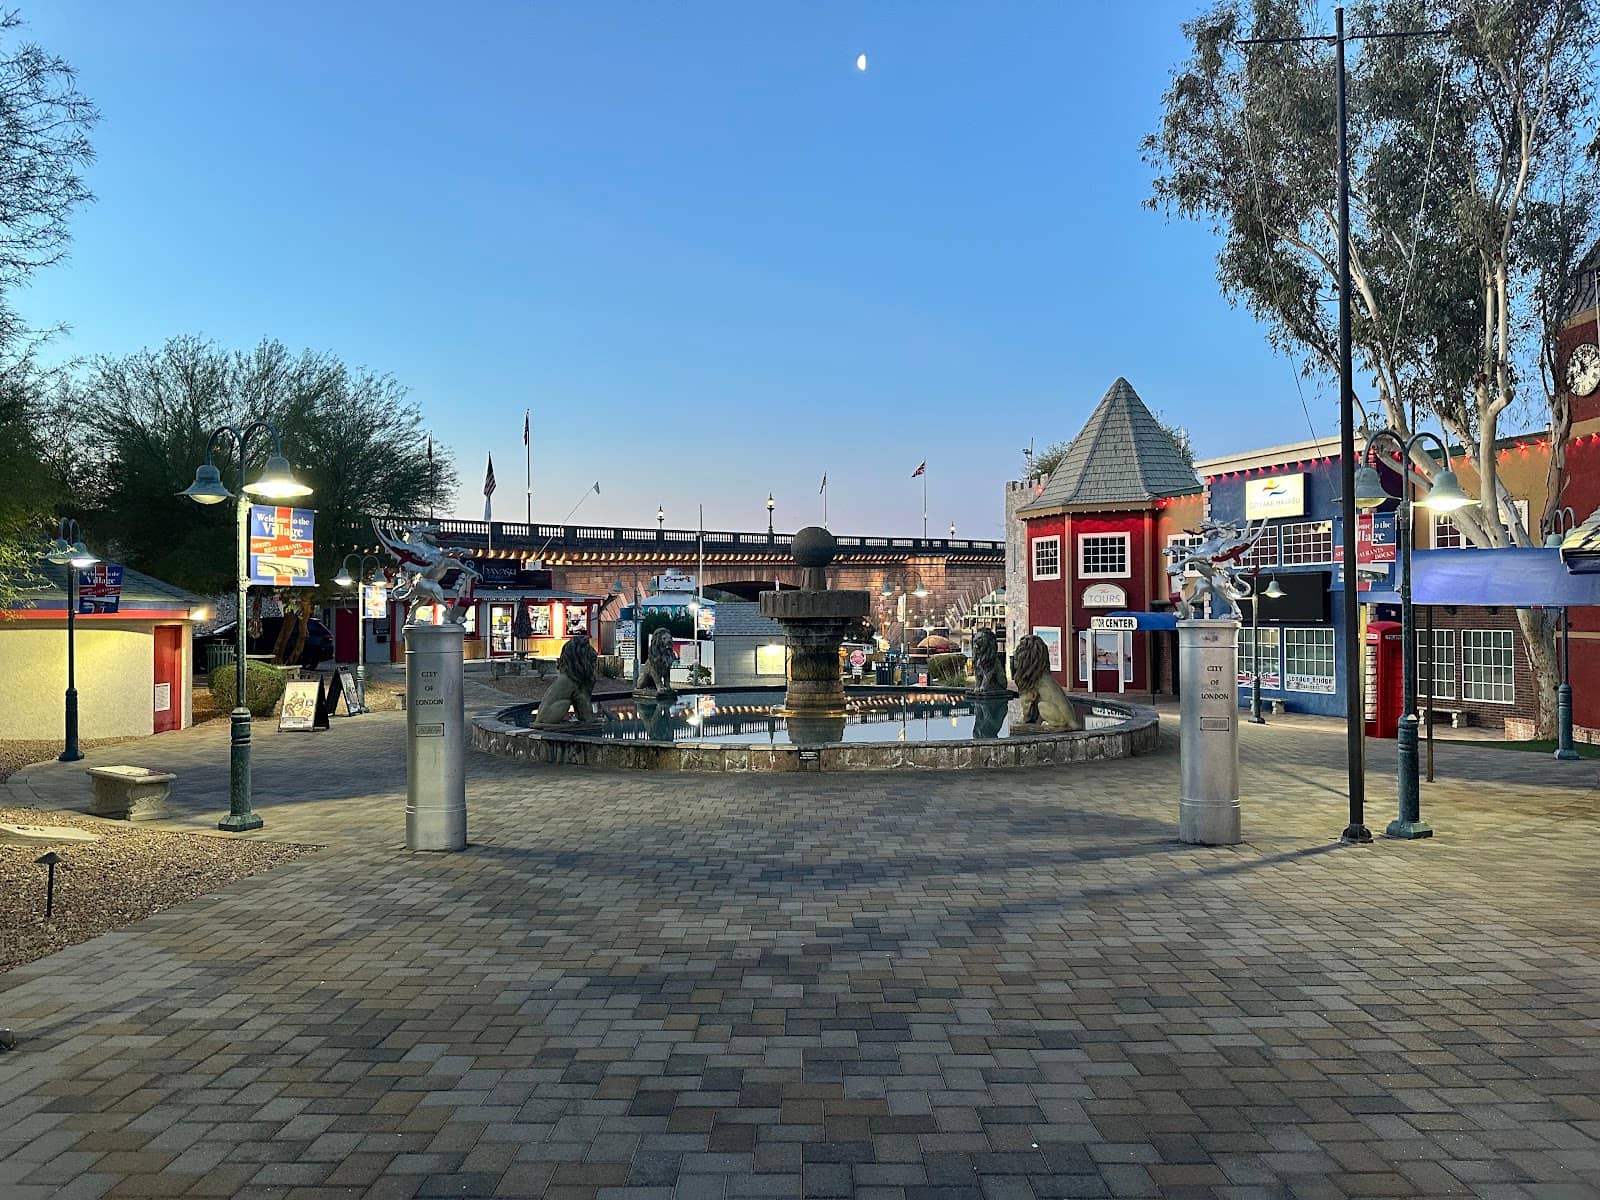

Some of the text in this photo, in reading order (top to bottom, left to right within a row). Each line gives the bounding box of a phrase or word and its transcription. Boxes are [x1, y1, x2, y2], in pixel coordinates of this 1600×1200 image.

[298, 517, 310, 526] the
[1380, 521, 1392, 529] the
[262, 522, 303, 539] Village
[1374, 551, 1395, 560] DOCKS
[1088, 594, 1120, 603] TOURS
[1105, 618, 1134, 629] CENTER
